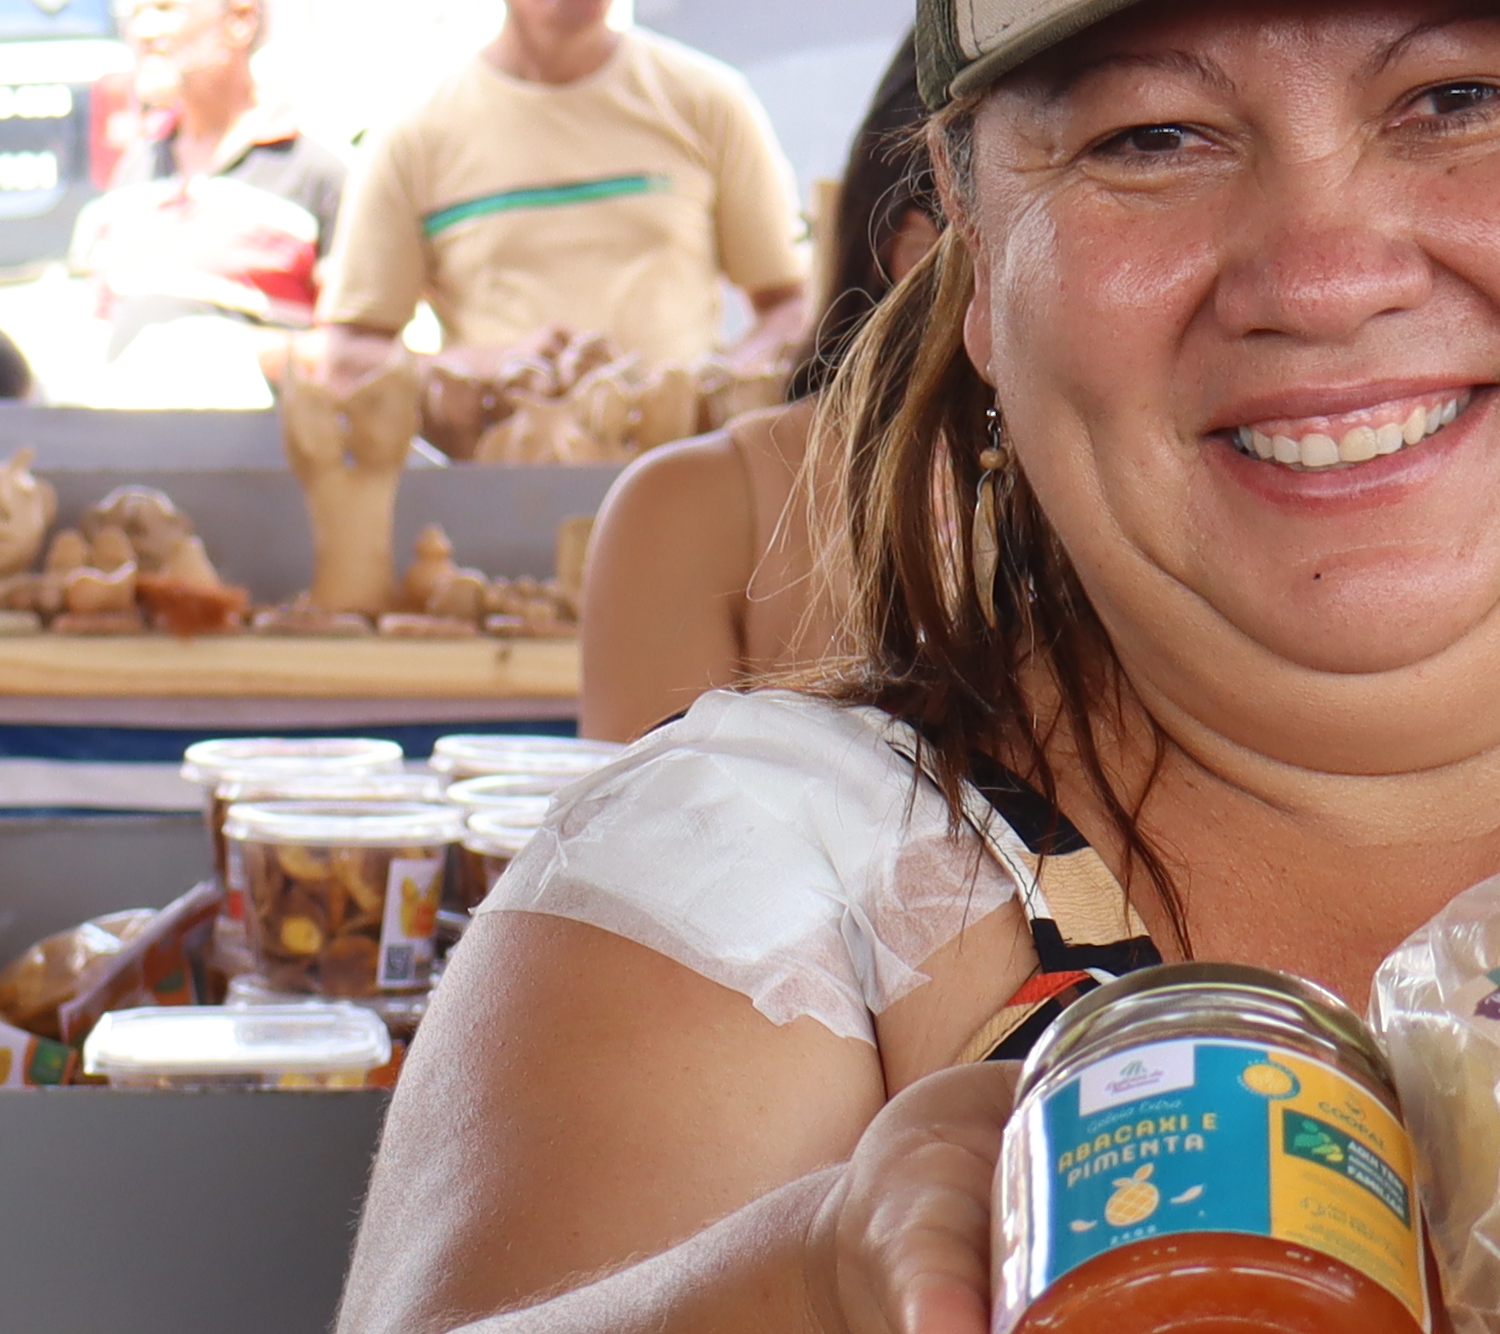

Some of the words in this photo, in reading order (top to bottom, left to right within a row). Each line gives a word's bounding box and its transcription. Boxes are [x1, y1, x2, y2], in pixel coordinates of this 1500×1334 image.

[1057, 1113, 1190, 1175] ABACAXI
[1201, 1112, 1218, 1131] E
[1066, 1133, 1206, 1189] PIMENTA
